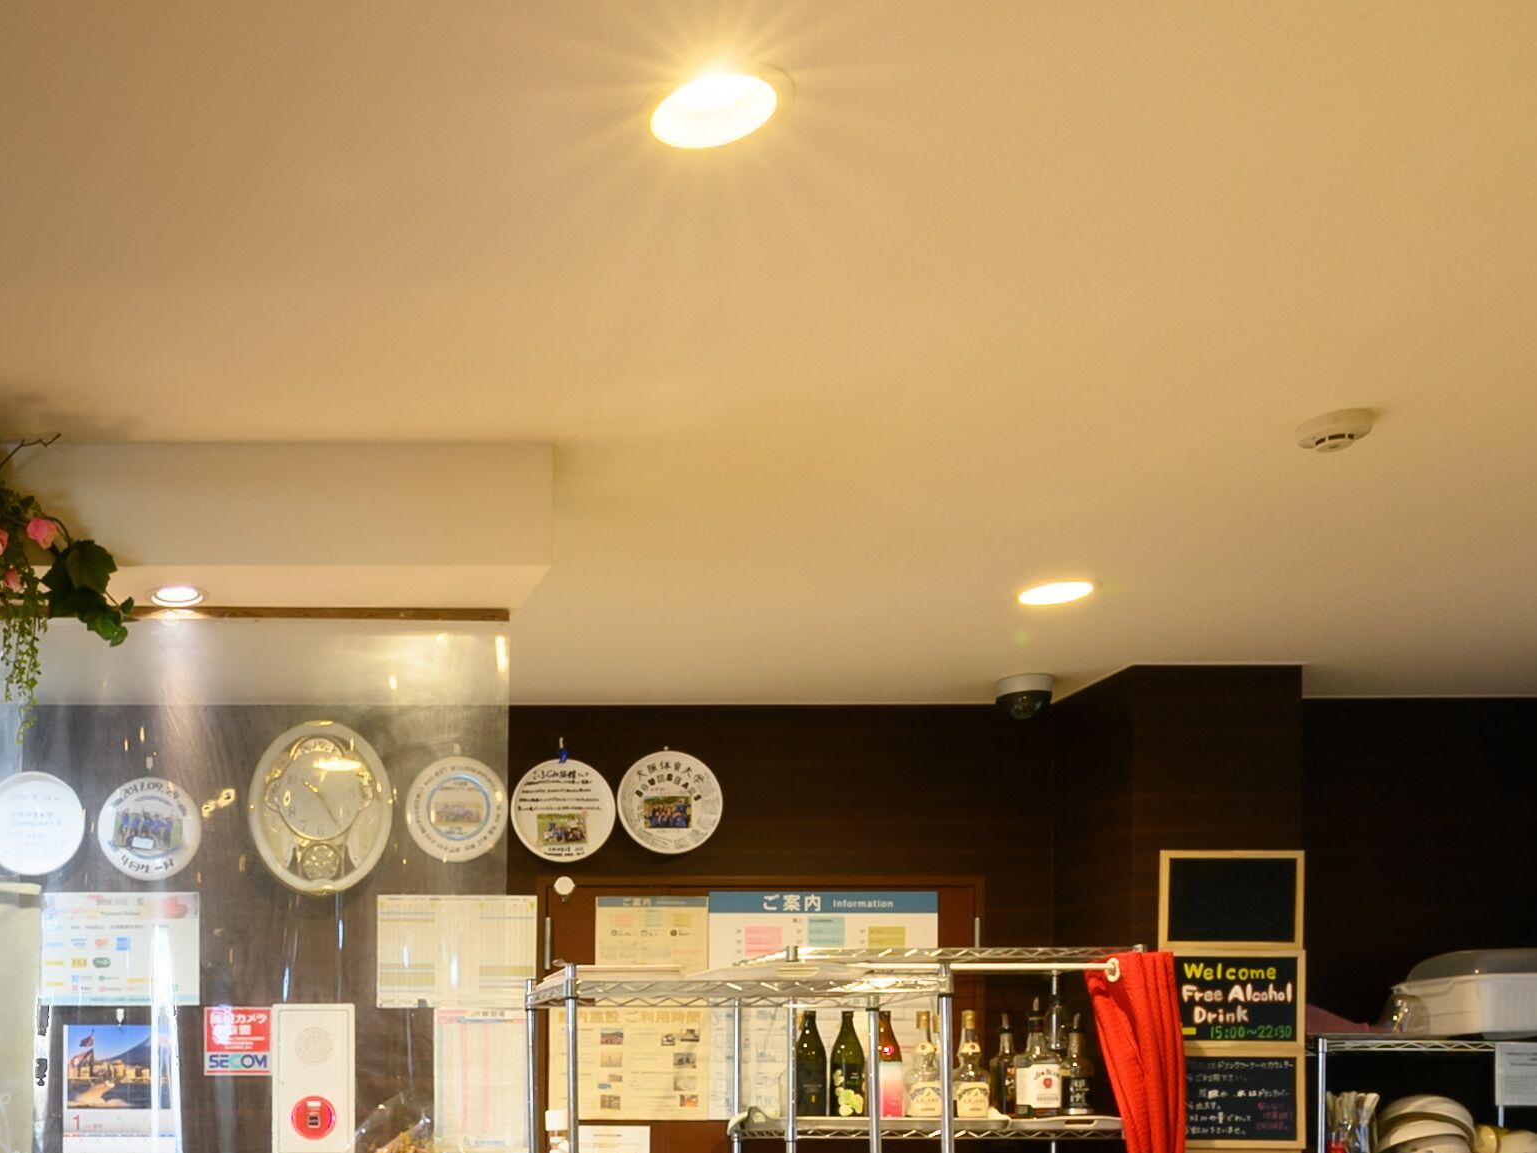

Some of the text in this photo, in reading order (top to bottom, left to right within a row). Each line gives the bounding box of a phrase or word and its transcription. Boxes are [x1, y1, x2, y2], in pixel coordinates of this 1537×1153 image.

[763, 894, 894, 913] ご案内 Information
[1183, 962, 1277, 980] Welcome
[1182, 981, 1293, 1003] Free Alcohol
[626, 1010, 701, 1024] ご利用時間
[1193, 1005, 1249, 1024] Drink
[209, 1054, 267, 1069] SECOM
